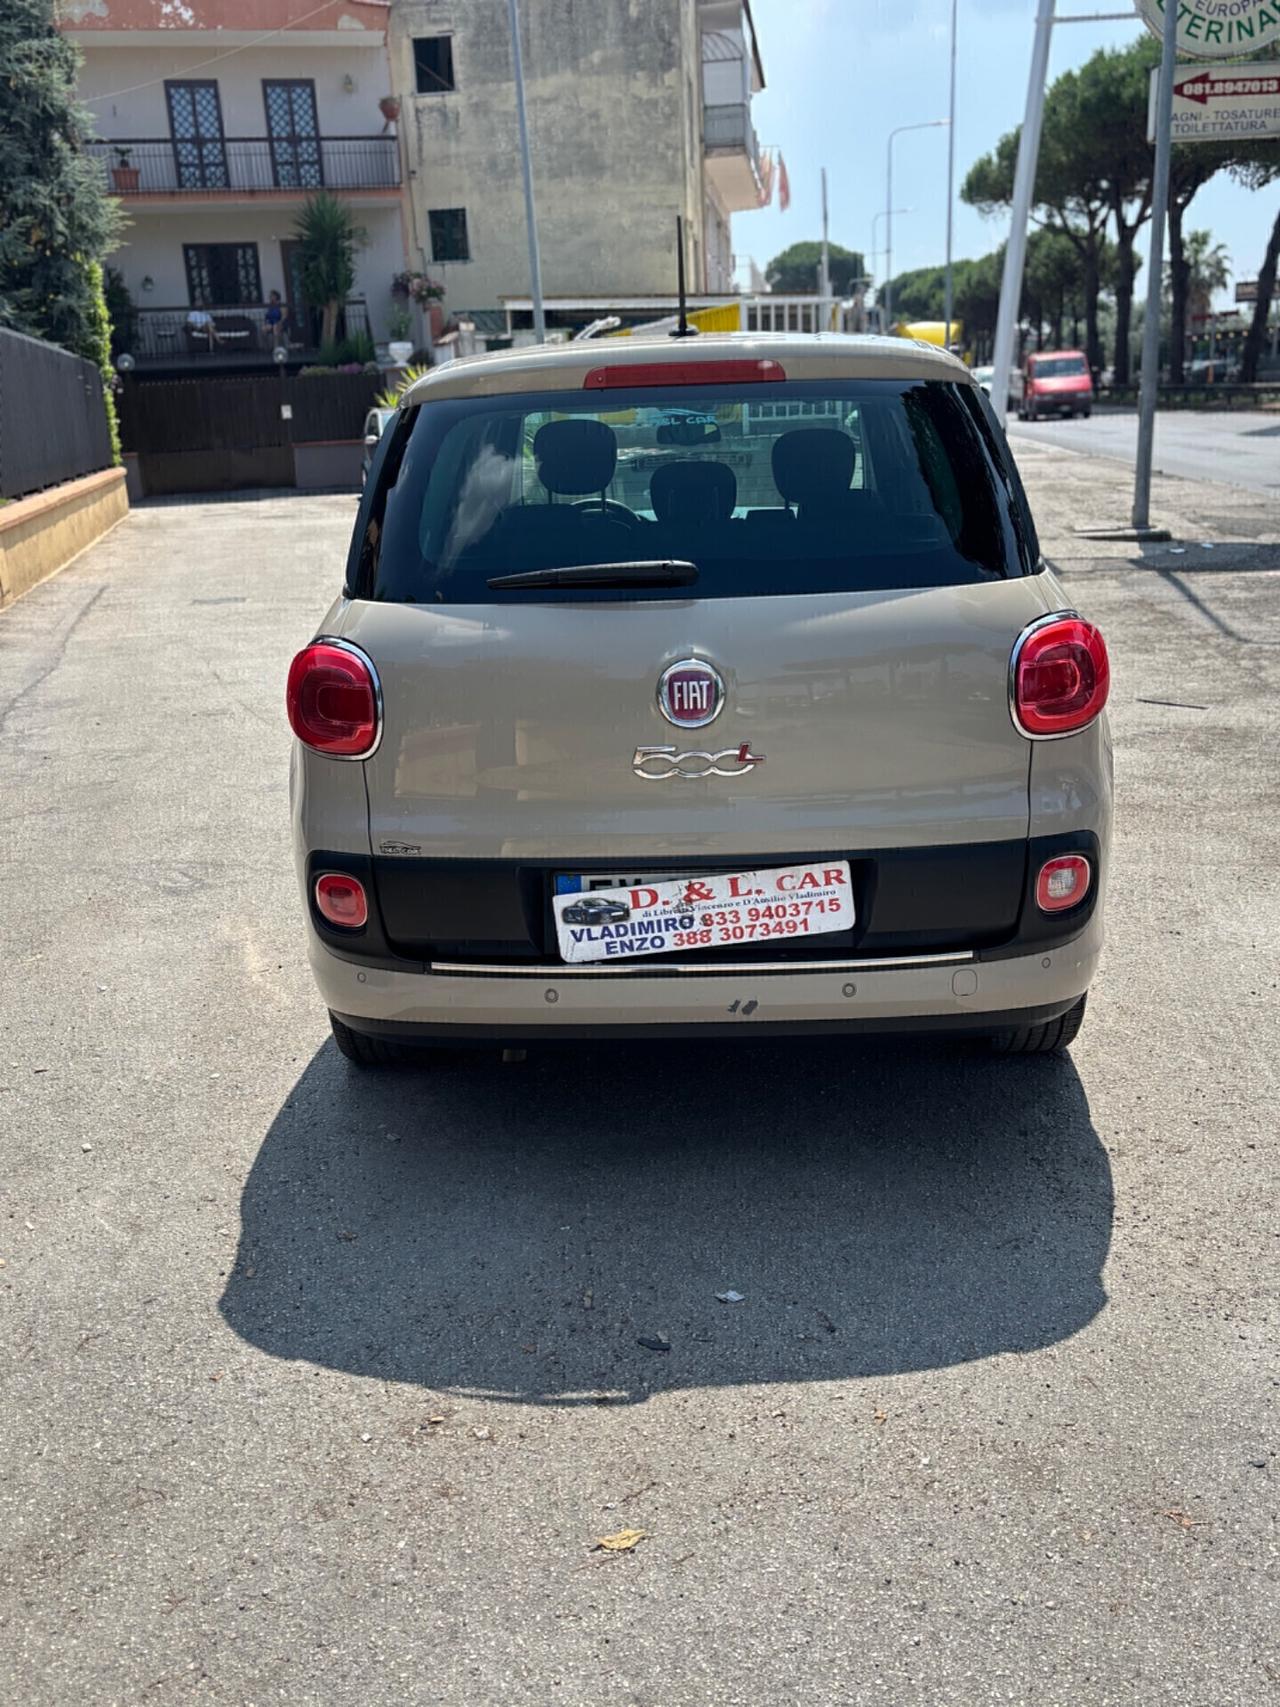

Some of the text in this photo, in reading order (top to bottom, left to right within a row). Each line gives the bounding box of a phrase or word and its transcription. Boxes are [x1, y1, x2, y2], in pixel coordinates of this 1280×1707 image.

[1155, 0, 1280, 44] TERINA
[1183, 80, 1278, 95] 081.8947013
[1171, 111, 1202, 122] AGNI
[1215, 108, 1280, 120] TOSATURE
[1174, 120, 1267, 133] TOILETTATURA
[673, 681, 710, 710] FIAT
[633, 742, 766, 779] 500L
[628, 887, 671, 910] D.
[683, 881, 716, 904] &
[727, 876, 766, 897] L.
[776, 868, 847, 892] CAR
[570, 914, 695, 943] VLADIMIRO
[747, 898, 842, 922] 9403715
[604, 918, 810, 955] ENZO 388 3073491
